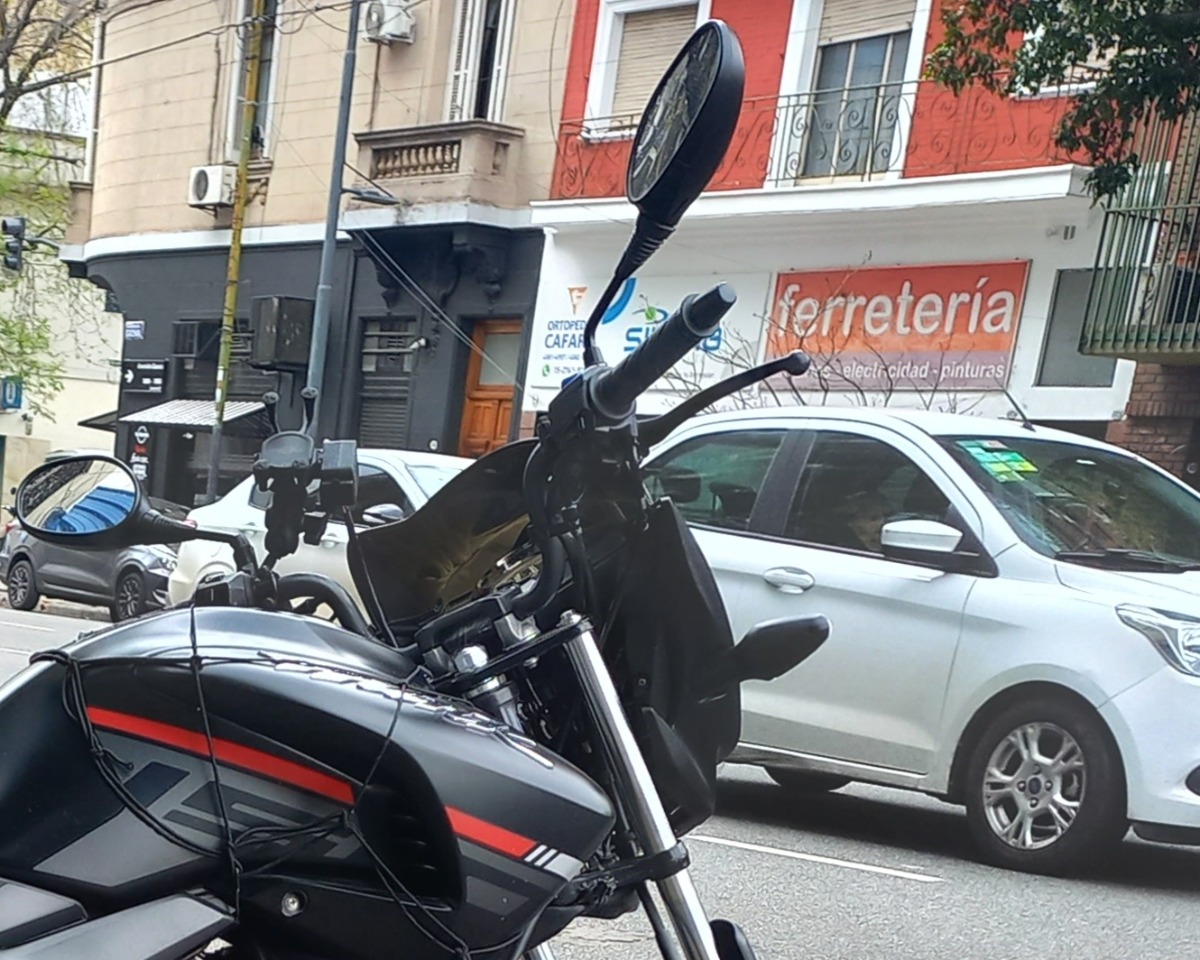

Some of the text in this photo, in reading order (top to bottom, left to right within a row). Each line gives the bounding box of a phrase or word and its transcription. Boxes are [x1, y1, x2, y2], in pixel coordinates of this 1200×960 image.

[778, 276, 1016, 337] ferretería
[547, 320, 586, 331] ORTOPED
[940, 358, 1005, 381] pinturas
